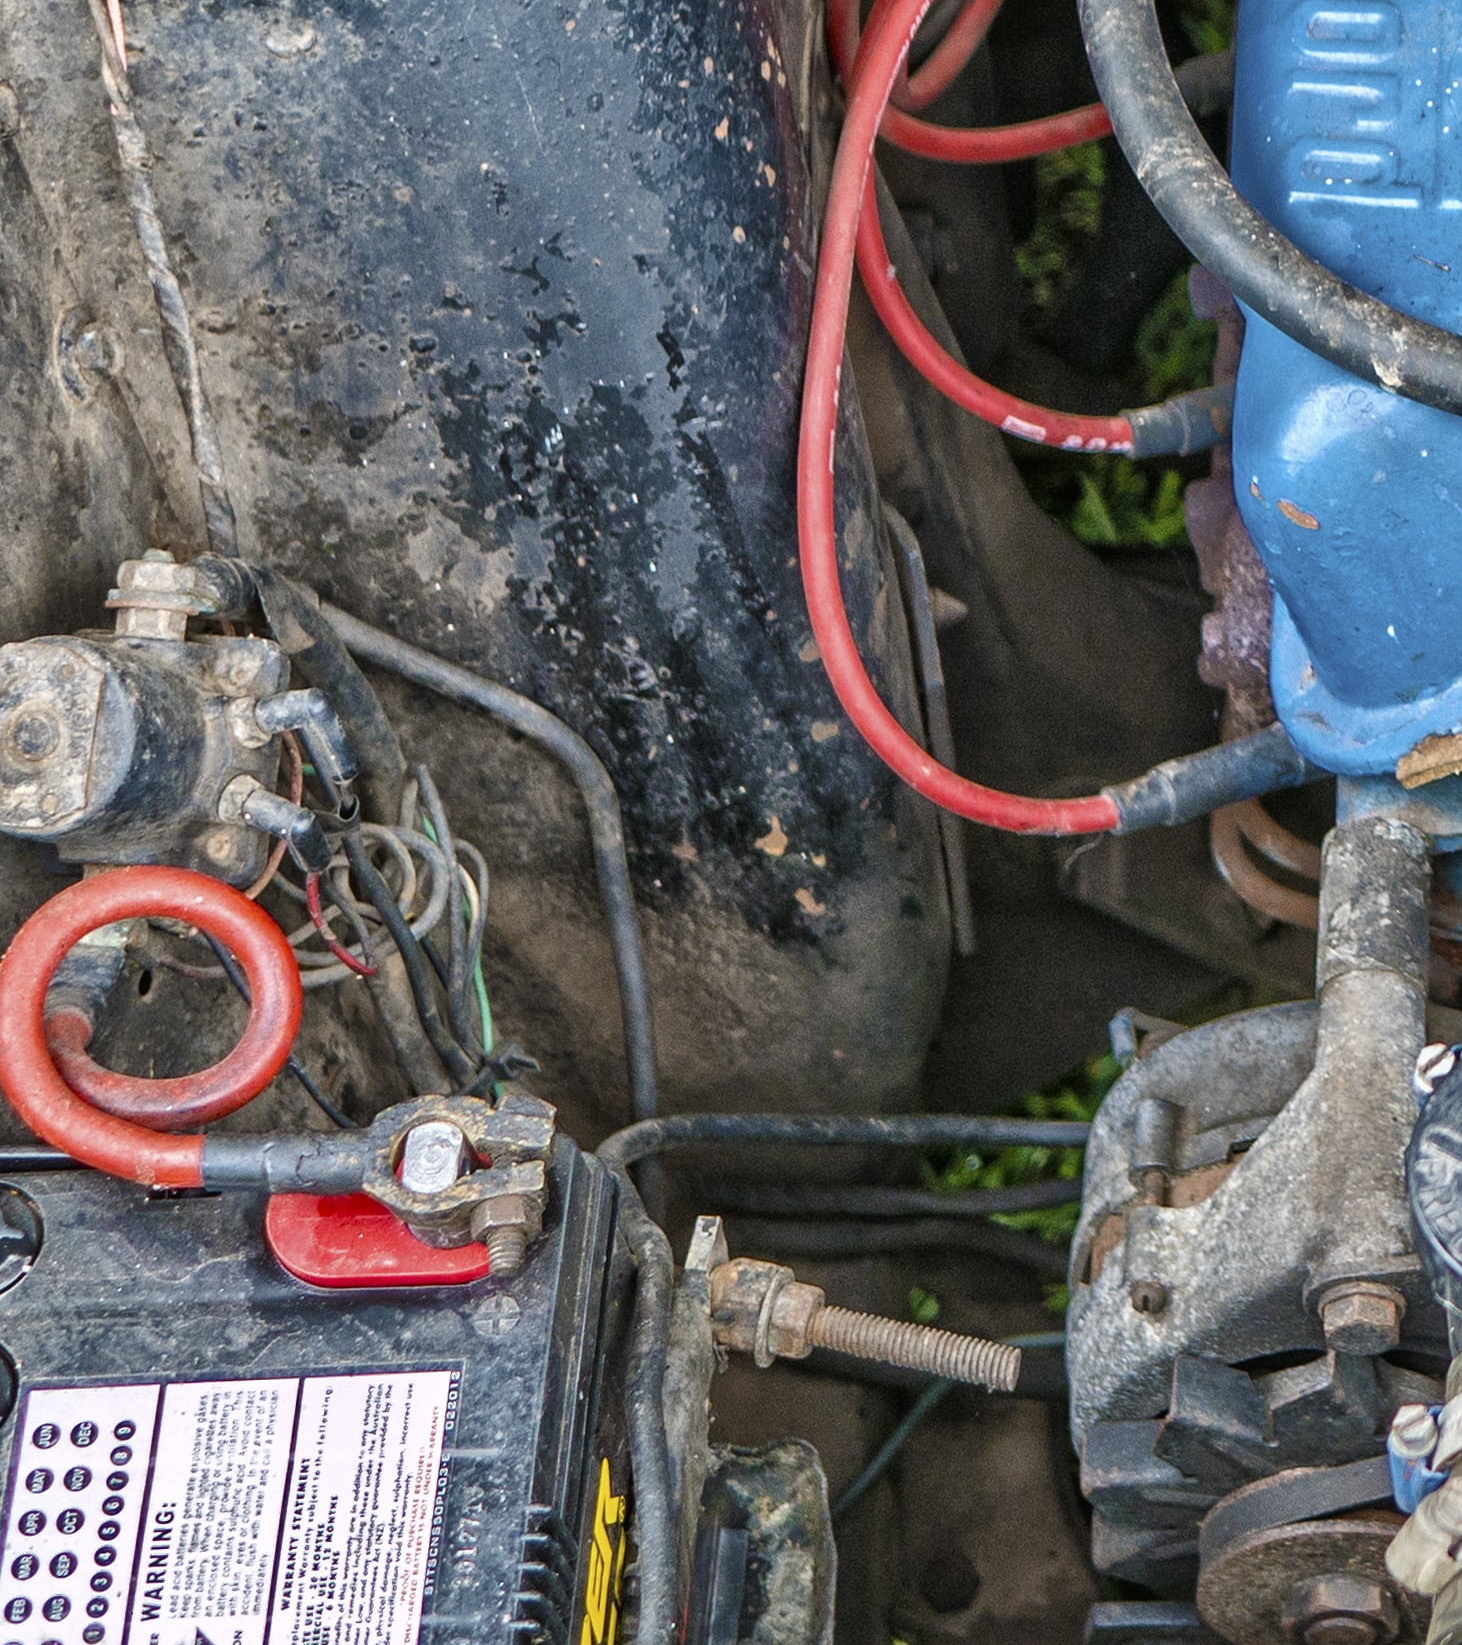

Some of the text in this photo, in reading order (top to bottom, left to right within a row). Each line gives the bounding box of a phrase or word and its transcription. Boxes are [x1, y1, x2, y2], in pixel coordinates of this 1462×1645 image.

[118, 1425, 130, 1434] 9
[113, 1450, 127, 1460] 8
[110, 1475, 123, 1484] 7
[181, 1476, 198, 1519] generate
[9, 1423, 53, 1621] FEB MAR APR MAY JUN
[49, 1421, 92, 1621] AUG SEP OCT NOV DEC
[106, 1500, 119, 1510] 6
[102, 1525, 114, 1535] 5
[174, 1522, 189, 1566] batteries
[279, 1456, 310, 1611] WARRANTY STATEMENT
[316, 1575, 328, 1596] USE
[324, 1494, 339, 1543] MONTHS
[98, 1550, 111, 1559] 4
[139, 1502, 177, 1622] WARNING:
[303, 1604, 315, 1626] USE
[311, 1523, 326, 1571] MONTHS
[326, 1550, 342, 1599] MONTHS
[95, 1577, 107, 1586] 3
[205, 1554, 220, 1601] enclosed
[91, 1602, 104, 1612] 2
